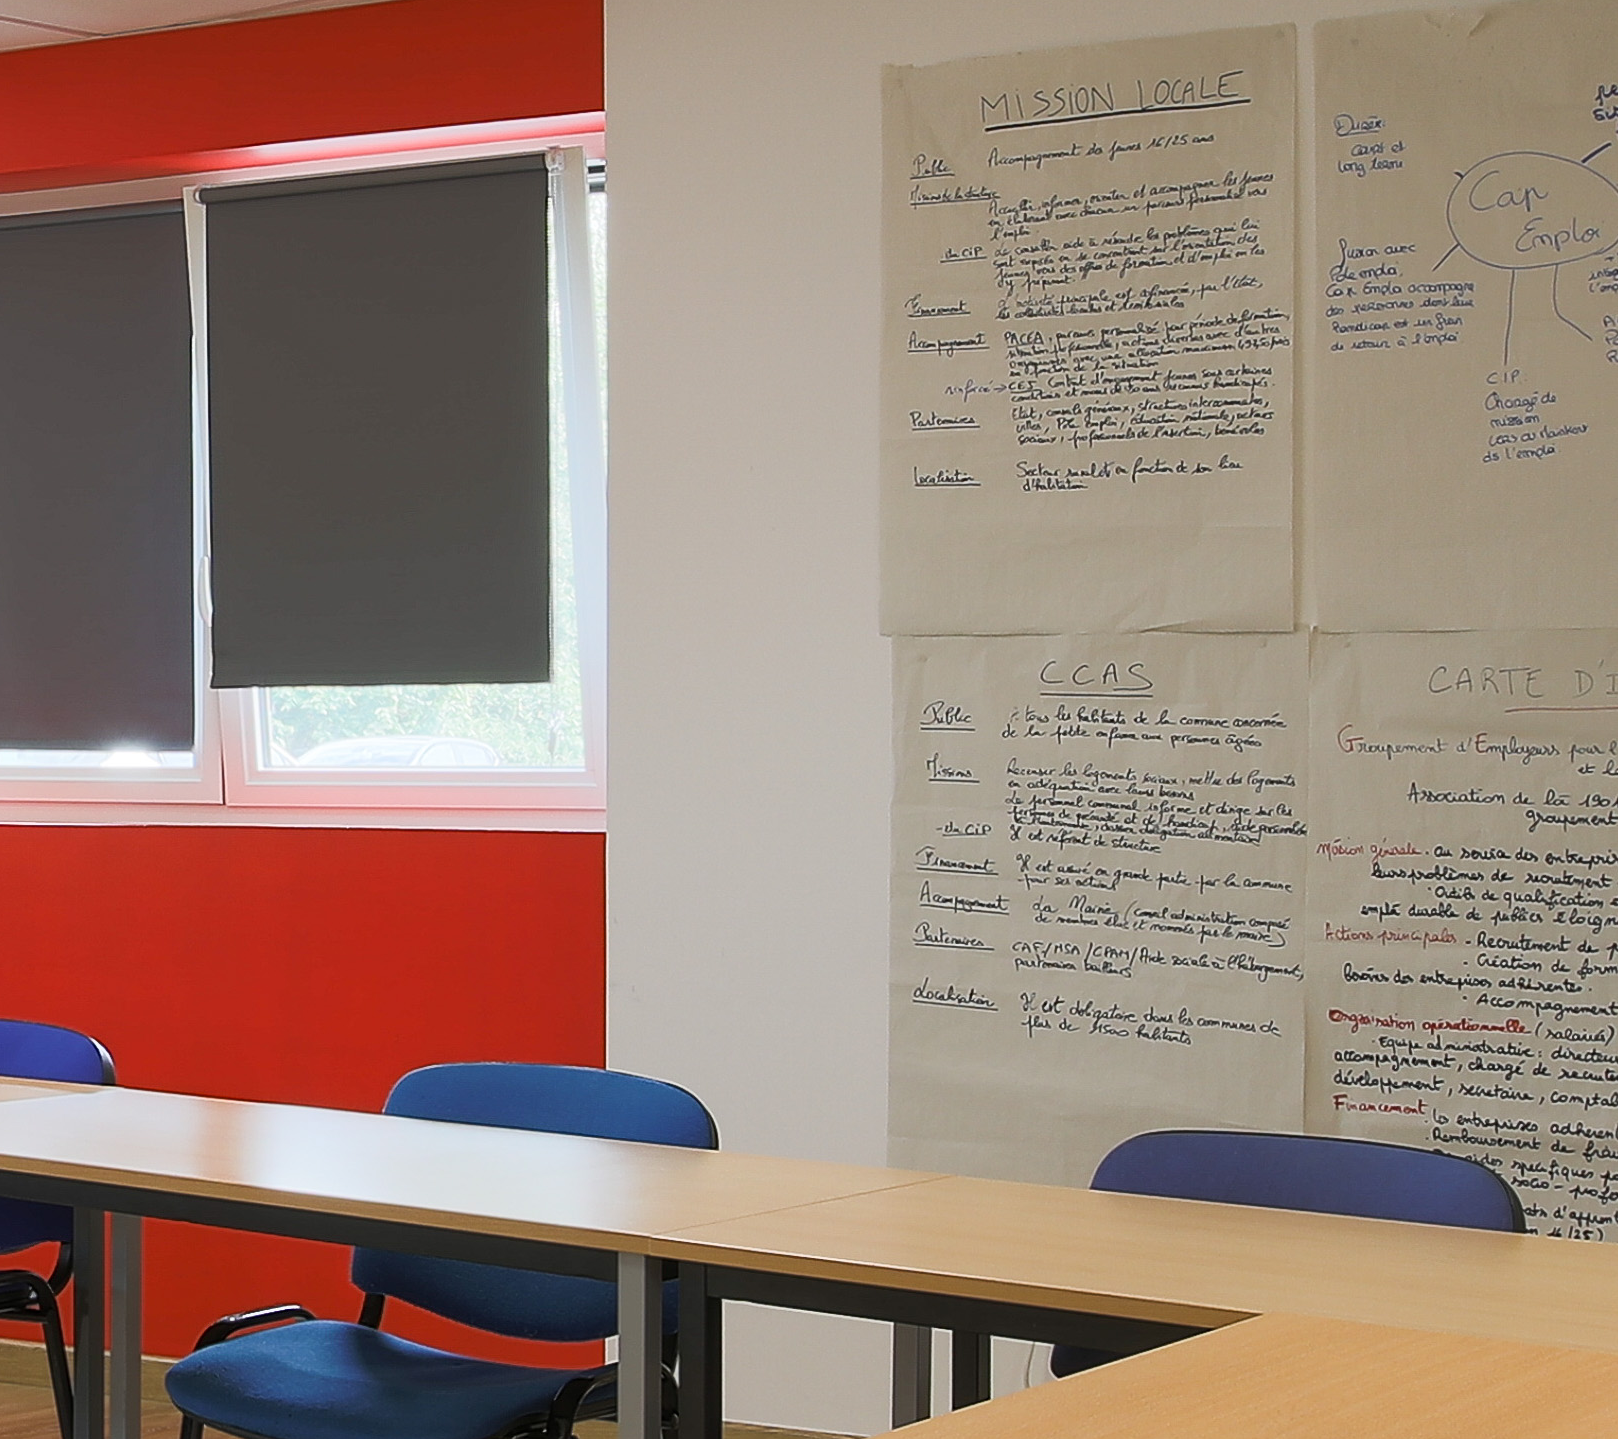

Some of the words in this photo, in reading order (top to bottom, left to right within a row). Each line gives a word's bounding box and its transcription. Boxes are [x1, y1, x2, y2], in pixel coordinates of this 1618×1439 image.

[1137, 70, 1243, 111] LOCALE
[1469, 169, 1549, 212] Cap
[1040, 660, 1153, 692] CCAS
[1428, 665, 1543, 699] CARTE
[1337, 723, 1449, 758] Groupement
[1567, 740, 1603, 761] pour
[1577, 764, 1595, 776] et
[1406, 782, 1506, 805] Association
[1513, 790, 1536, 805] de
